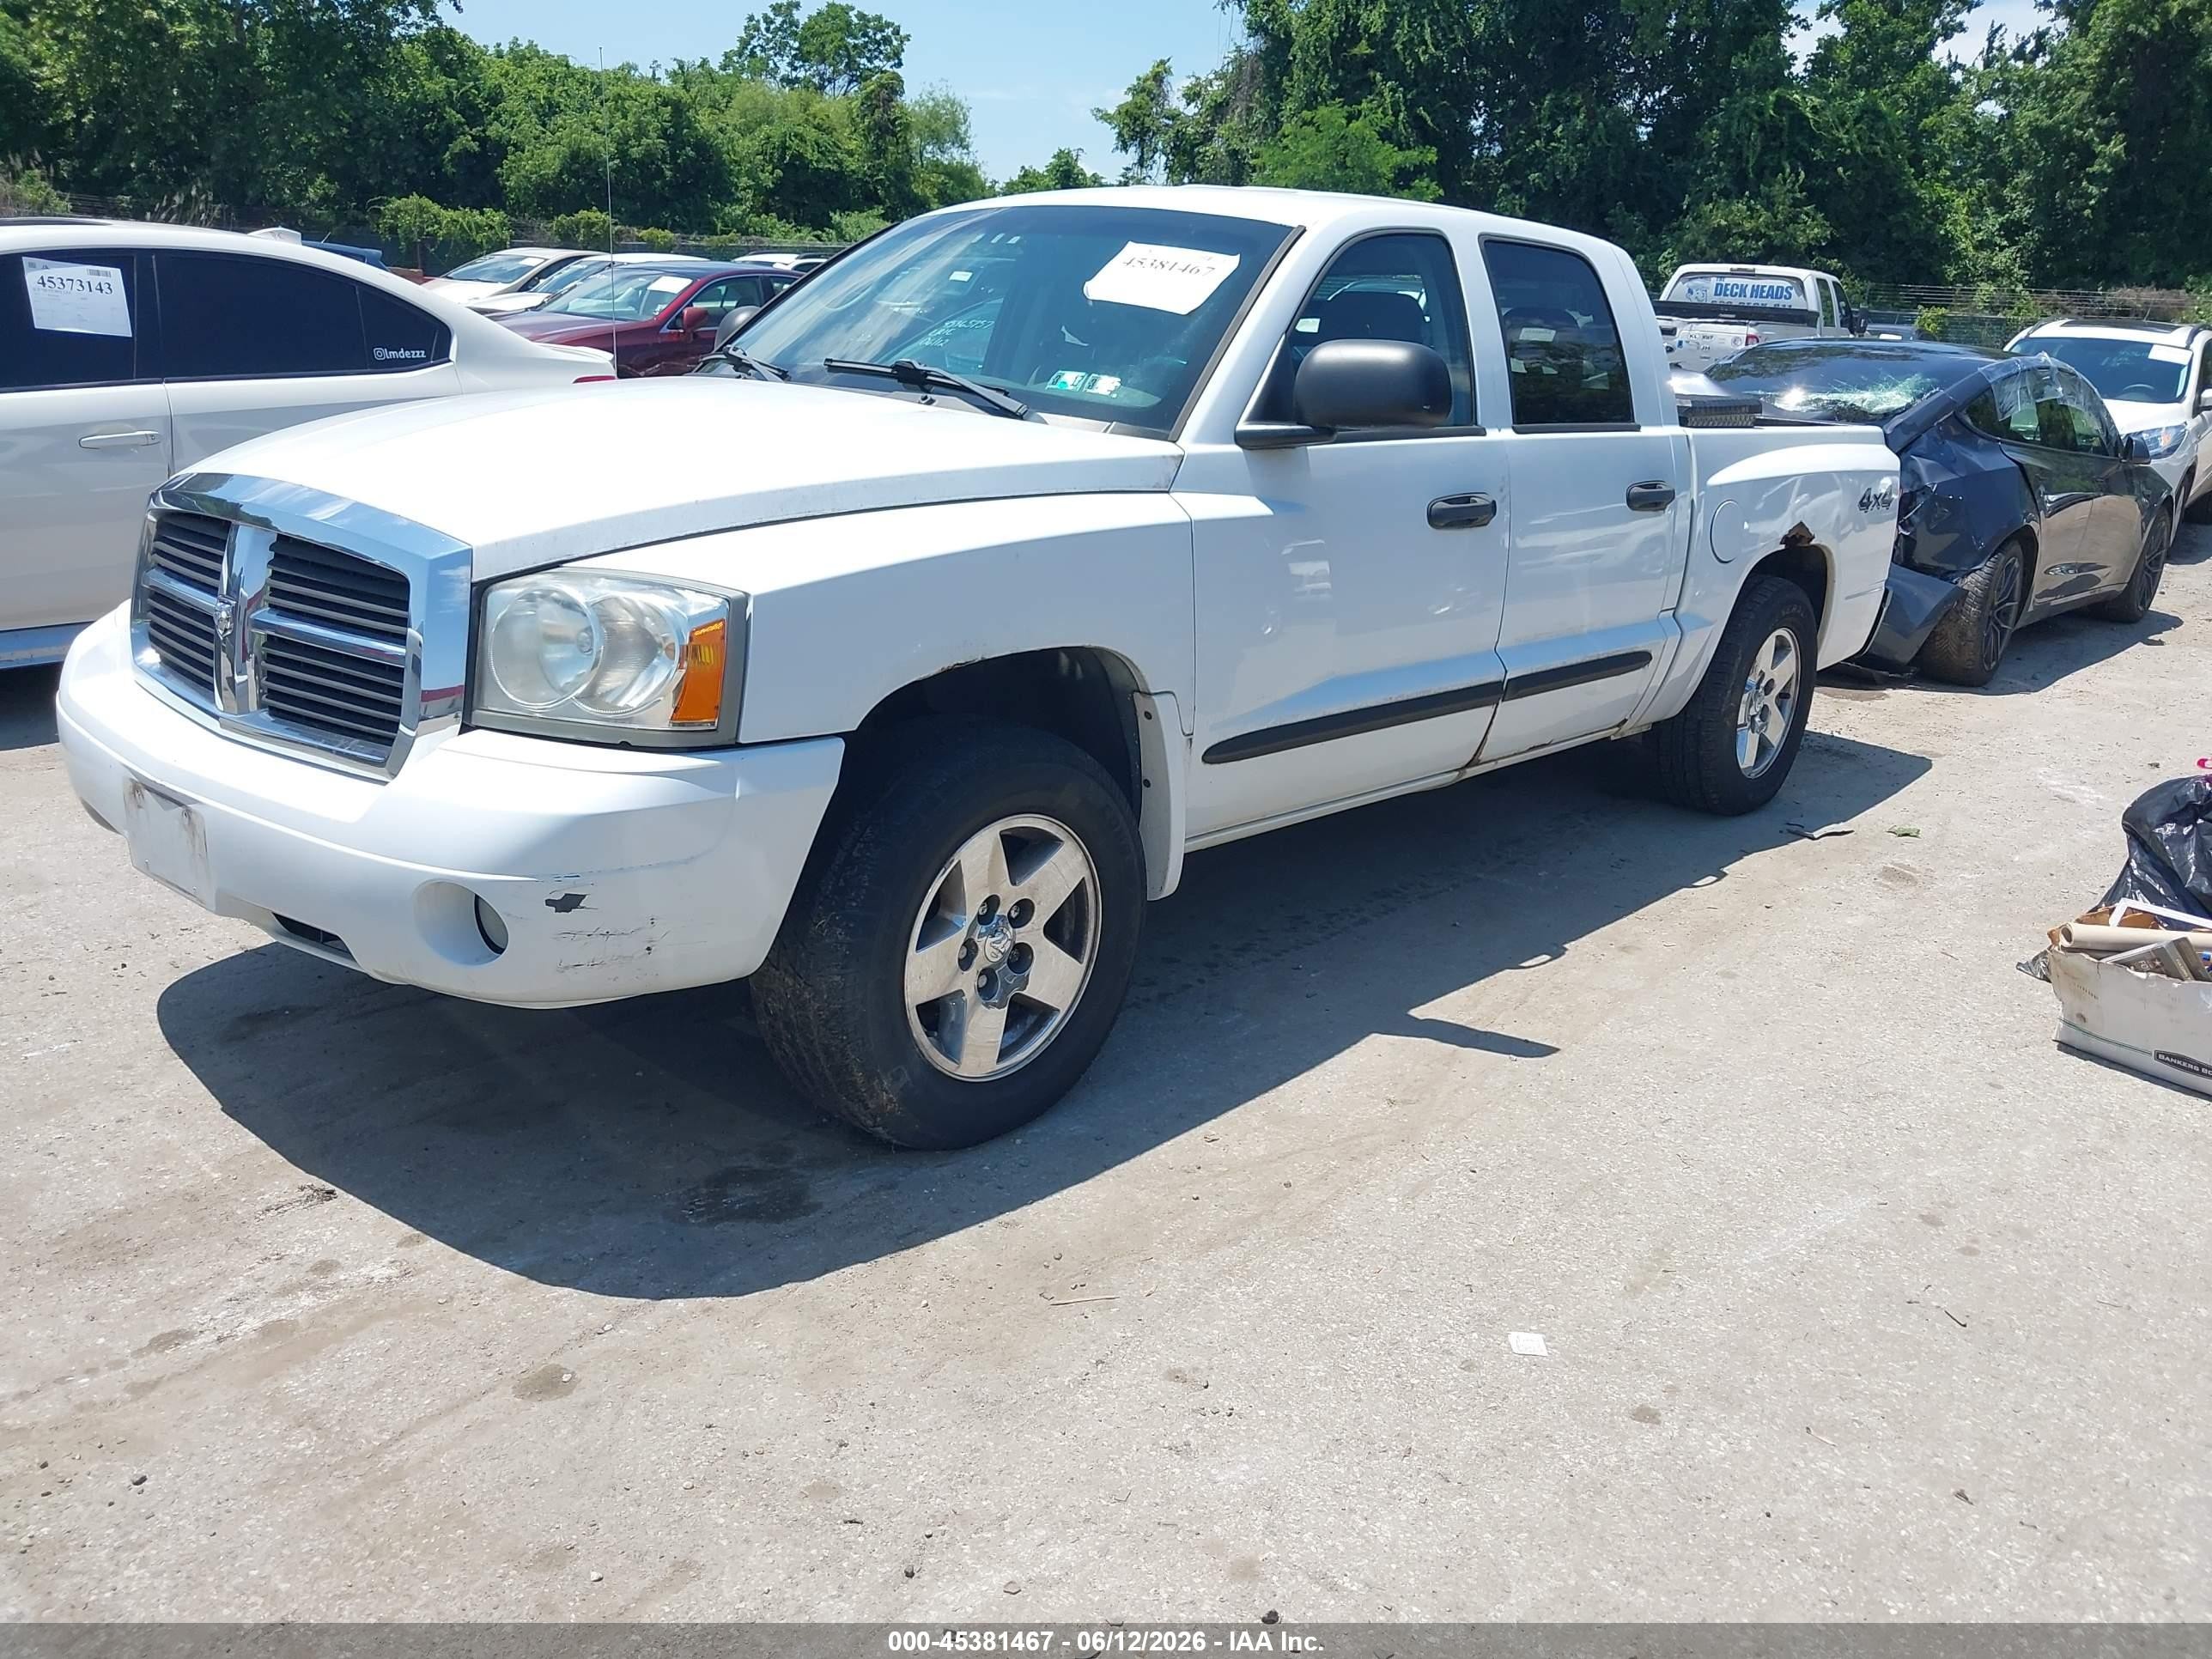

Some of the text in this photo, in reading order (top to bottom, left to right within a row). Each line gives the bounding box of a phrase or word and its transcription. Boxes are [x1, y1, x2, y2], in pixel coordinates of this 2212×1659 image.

[1122, 257, 1216, 276] 45381467
[37, 275, 113, 295] 45373143
[1714, 283, 1794, 301] DECK HEADS
[1858, 484, 1894, 514] 4x4
[2158, 1053, 2200, 1072] BANKERS
